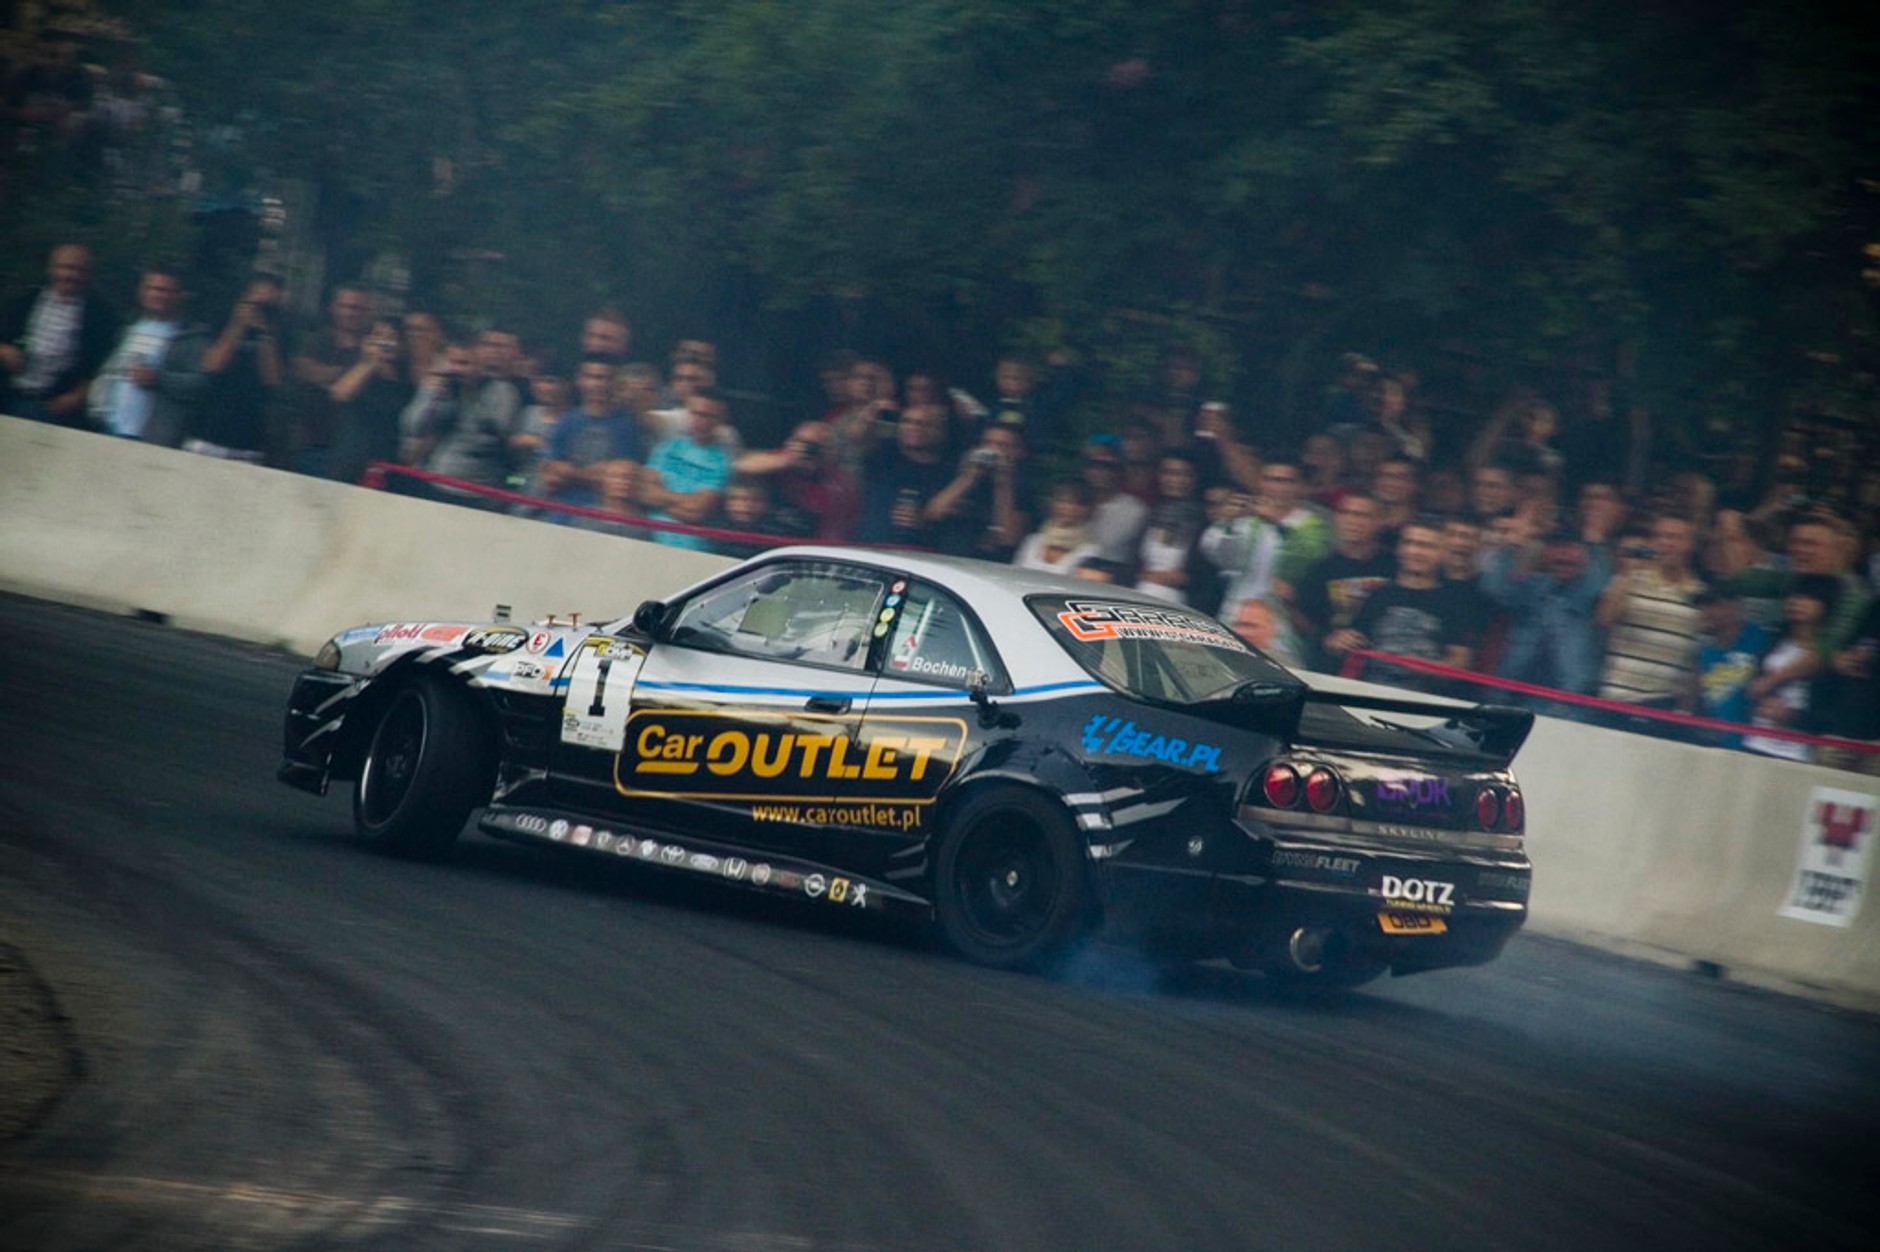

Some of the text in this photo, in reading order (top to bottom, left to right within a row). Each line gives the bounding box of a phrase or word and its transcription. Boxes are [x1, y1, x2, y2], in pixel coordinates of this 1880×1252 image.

[912, 656, 984, 679] Bochen
[588, 659, 613, 717] 1
[636, 725, 703, 759] Car
[706, 730, 946, 781] OUTLET
[752, 804, 921, 831] www.caroutlet.pl
[1382, 875, 1455, 906] DOTZ
